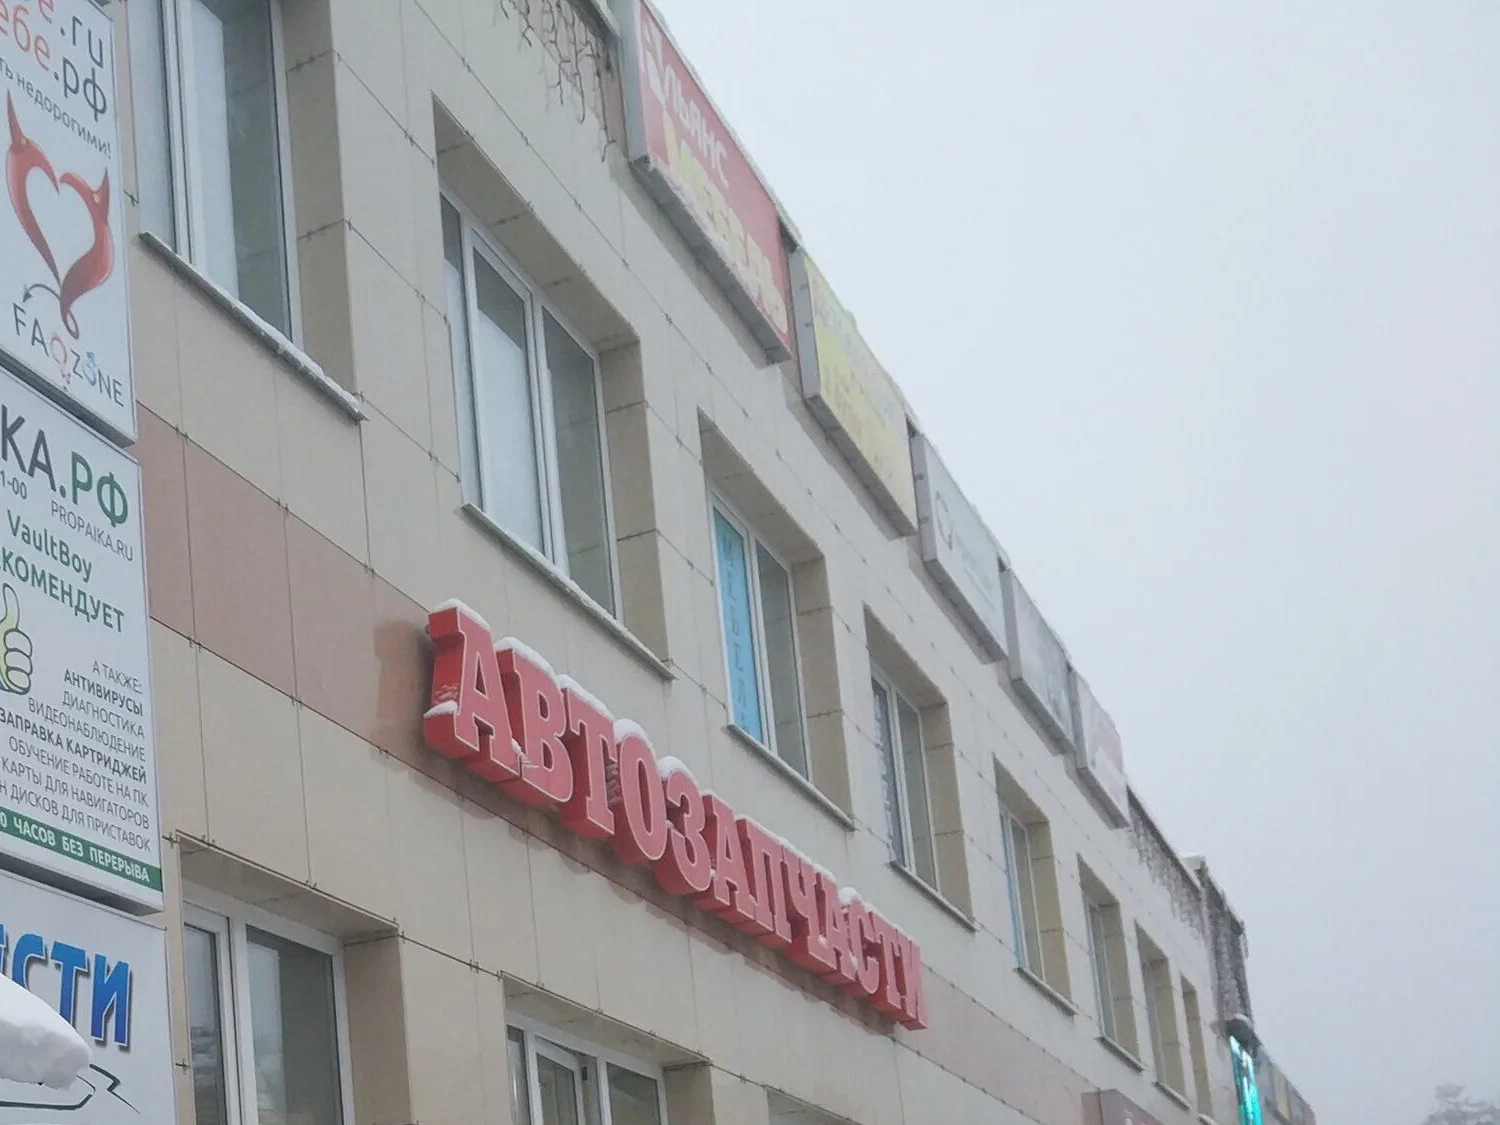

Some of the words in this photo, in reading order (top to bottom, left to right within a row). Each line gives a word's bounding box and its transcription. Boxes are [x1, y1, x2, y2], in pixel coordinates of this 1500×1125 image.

[17, 71, 112, 160] недорогими!
[7, 508, 92, 583] VaultBoy
[51, 500, 133, 562] PROPAIKA.RU
[64, 668, 144, 716] АНТИВИРУСЫ
[92, 660, 101, 674] А
[102, 664, 142, 694] ТАКЖЕ:
[28, 696, 146, 762] ВИДЕОНАБЛЮДЕНИЕ
[62, 690, 145, 740] ДИАГНОСТИКА
[1, 756, 42, 786] КАРТЫ
[45, 775, 69, 794] ДЛЯ
[72, 787, 150, 830] НАВИГАТОРОВ
[9, 735, 70, 772] ОБУЧЕНИЕ
[73, 763, 114, 794] РАБОТЕ
[116, 782, 131, 800] НА
[133, 790, 149, 809] ПК
[66, 737, 147, 785] КАРТРИДЖЕЙ
[11, 784, 59, 816] ДИСКОВ
[62, 805, 85, 824] ДЛЯ
[86, 813, 152, 853] ПРИСТАВОК
[13, 815, 55, 847] ЧАСОВ
[62, 835, 84, 857] БЕЗ
[90, 846, 150, 883] ПЕРЕРЫВА
[425, 604, 927, 1031] АВТОЗАПЧАСТИ
